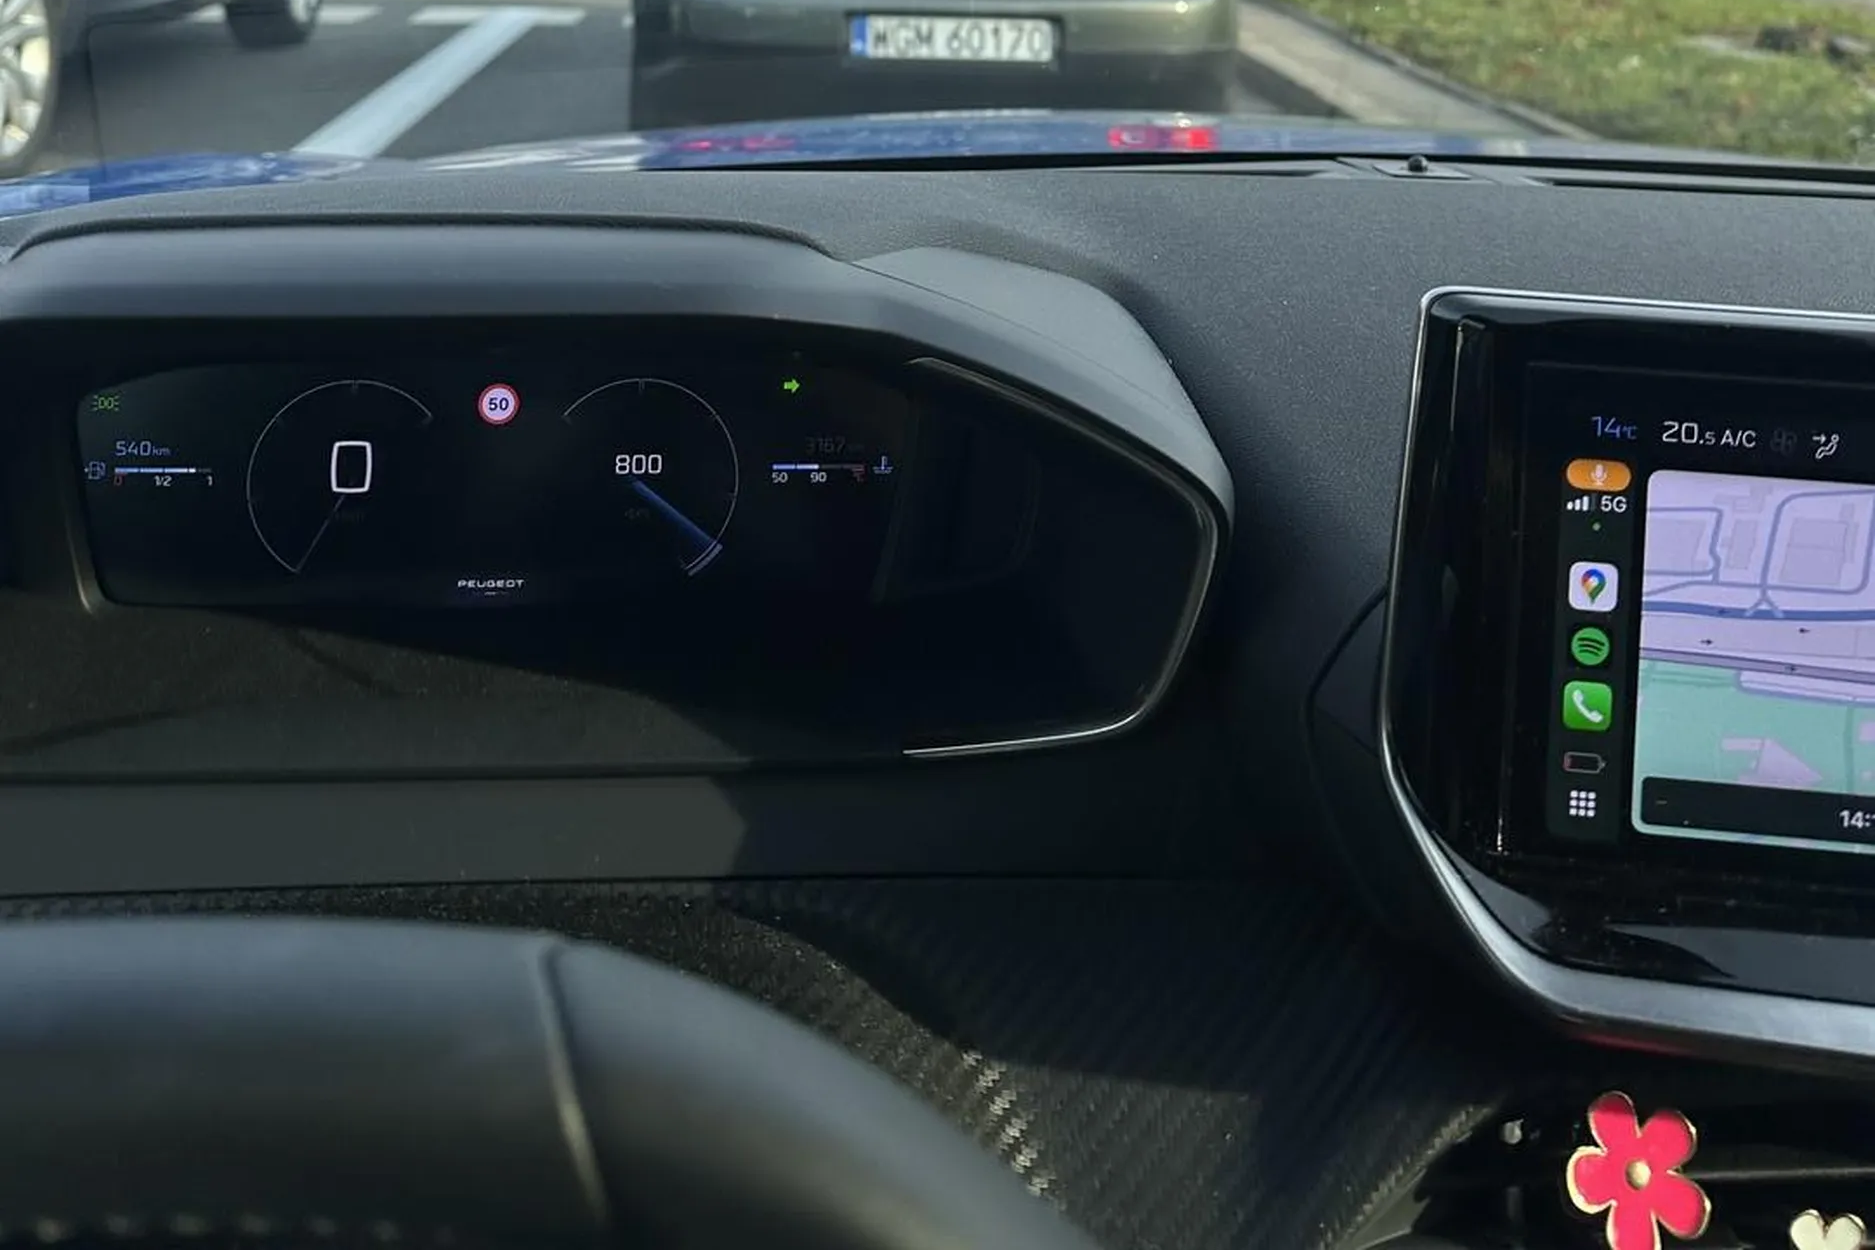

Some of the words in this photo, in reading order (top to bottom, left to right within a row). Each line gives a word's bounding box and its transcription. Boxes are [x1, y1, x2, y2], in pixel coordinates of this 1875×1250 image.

[946, 21, 1049, 58] 60170
[489, 397, 510, 411] 50
[1662, 421, 1716, 445] 20.5
[1720, 430, 1757, 447] A/C
[331, 440, 373, 493] 0
[615, 454, 662, 474] 800
[771, 472, 788, 483] 50
[810, 472, 827, 483] 90
[1600, 496, 1627, 512] 5G
[457, 579, 525, 588] PEUGEOT
[1839, 810, 1875, 828] 14:
